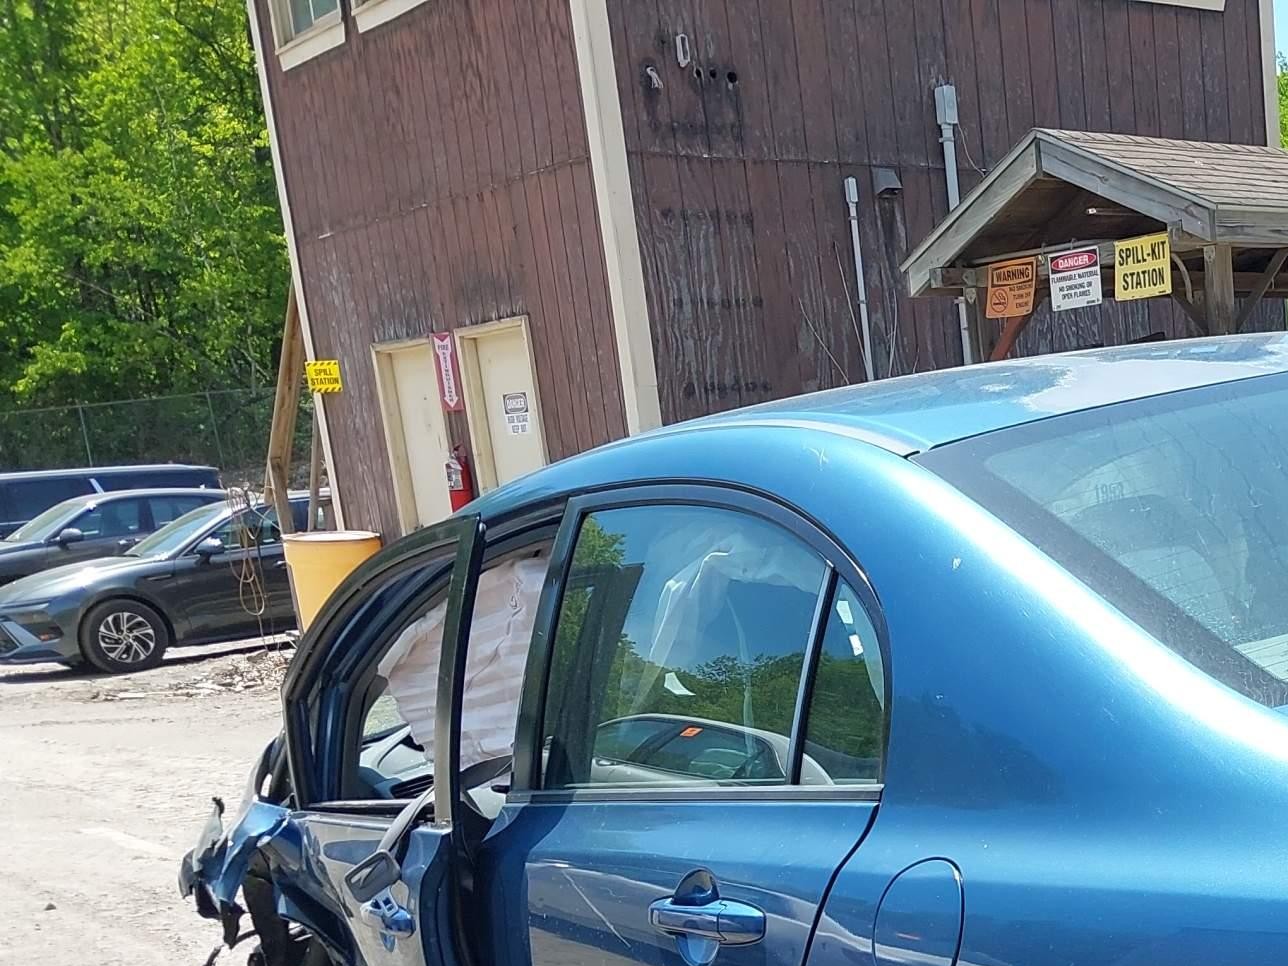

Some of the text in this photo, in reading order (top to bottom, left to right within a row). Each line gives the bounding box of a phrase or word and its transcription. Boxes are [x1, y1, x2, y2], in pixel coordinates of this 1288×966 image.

[1118, 240, 1167, 267] SPILL-KIT
[1058, 255, 1089, 268] DANGER
[995, 267, 1030, 281] WARNING
[1077, 269, 1099, 279] MATERIAL
[1122, 267, 1165, 291] STATION
[314, 368, 332, 376] SPILL
[311, 377, 339, 385] STATION
